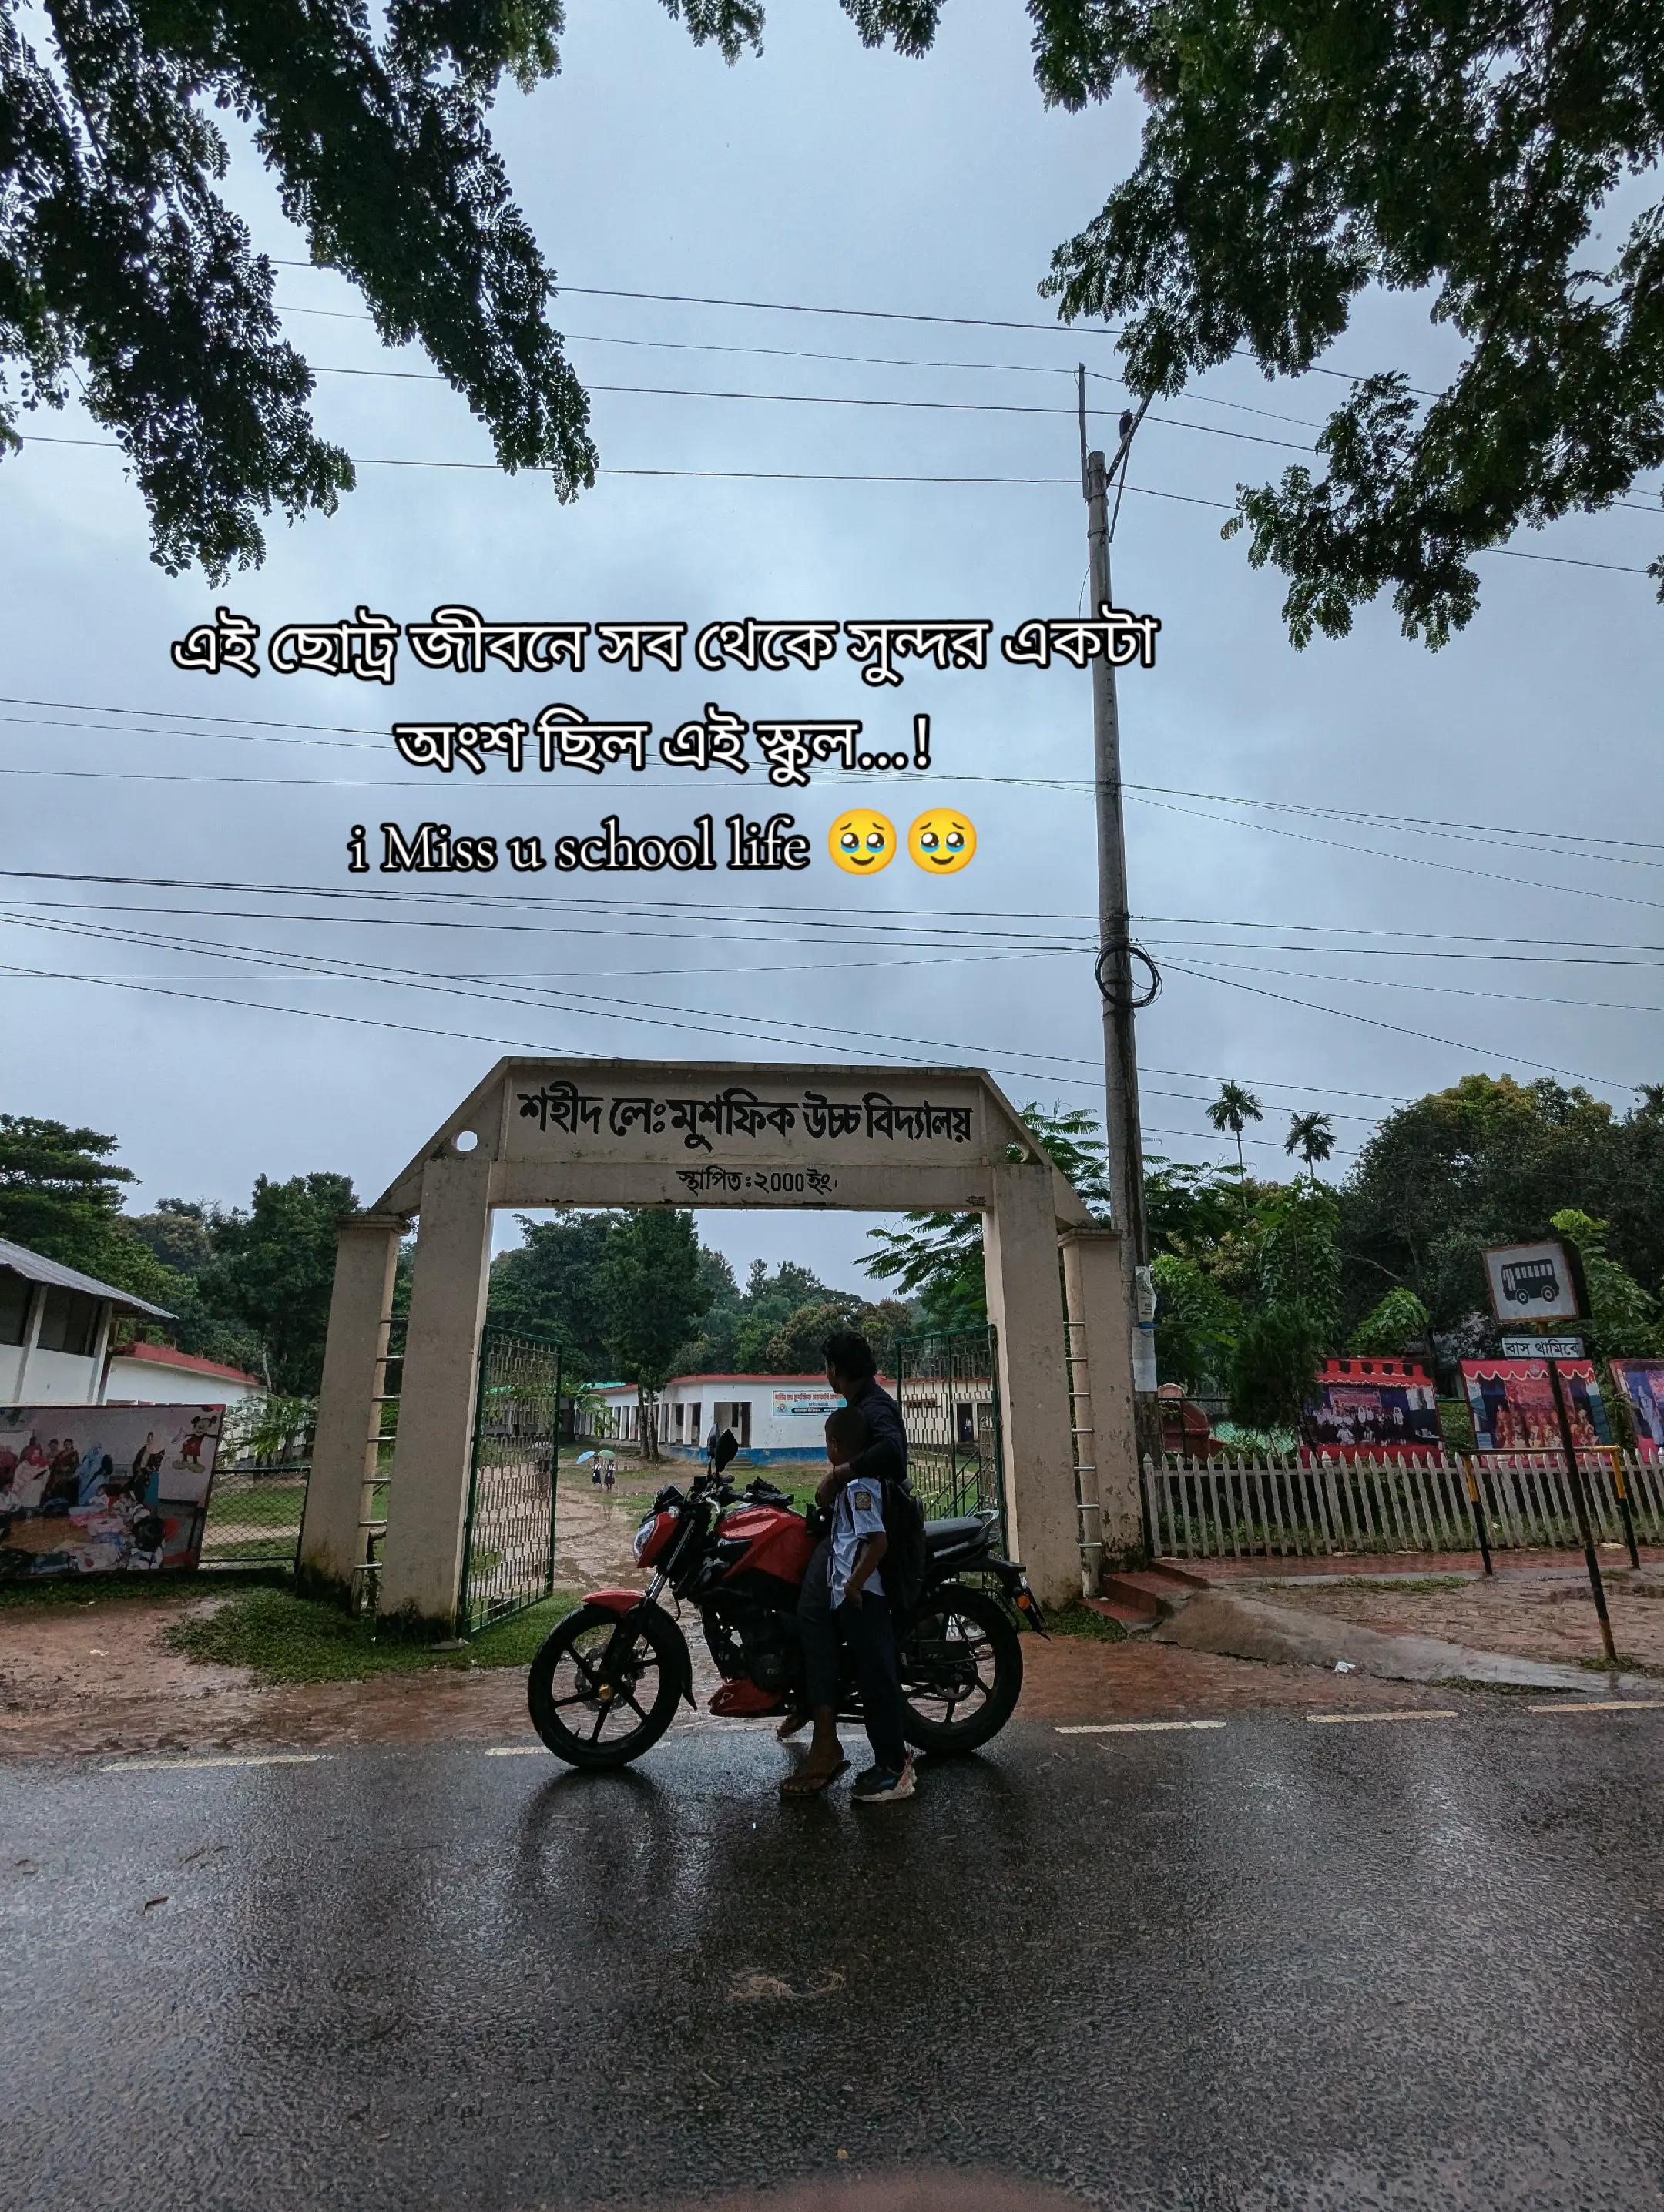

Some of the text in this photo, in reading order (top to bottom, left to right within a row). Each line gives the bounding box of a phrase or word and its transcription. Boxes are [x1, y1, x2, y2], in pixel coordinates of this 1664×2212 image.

[517, 1080, 606, 1135] শহীদ
[802, 1091, 862, 1138] উচ্চ
[1505, 1339, 1579, 1356] বাস থামিবে
